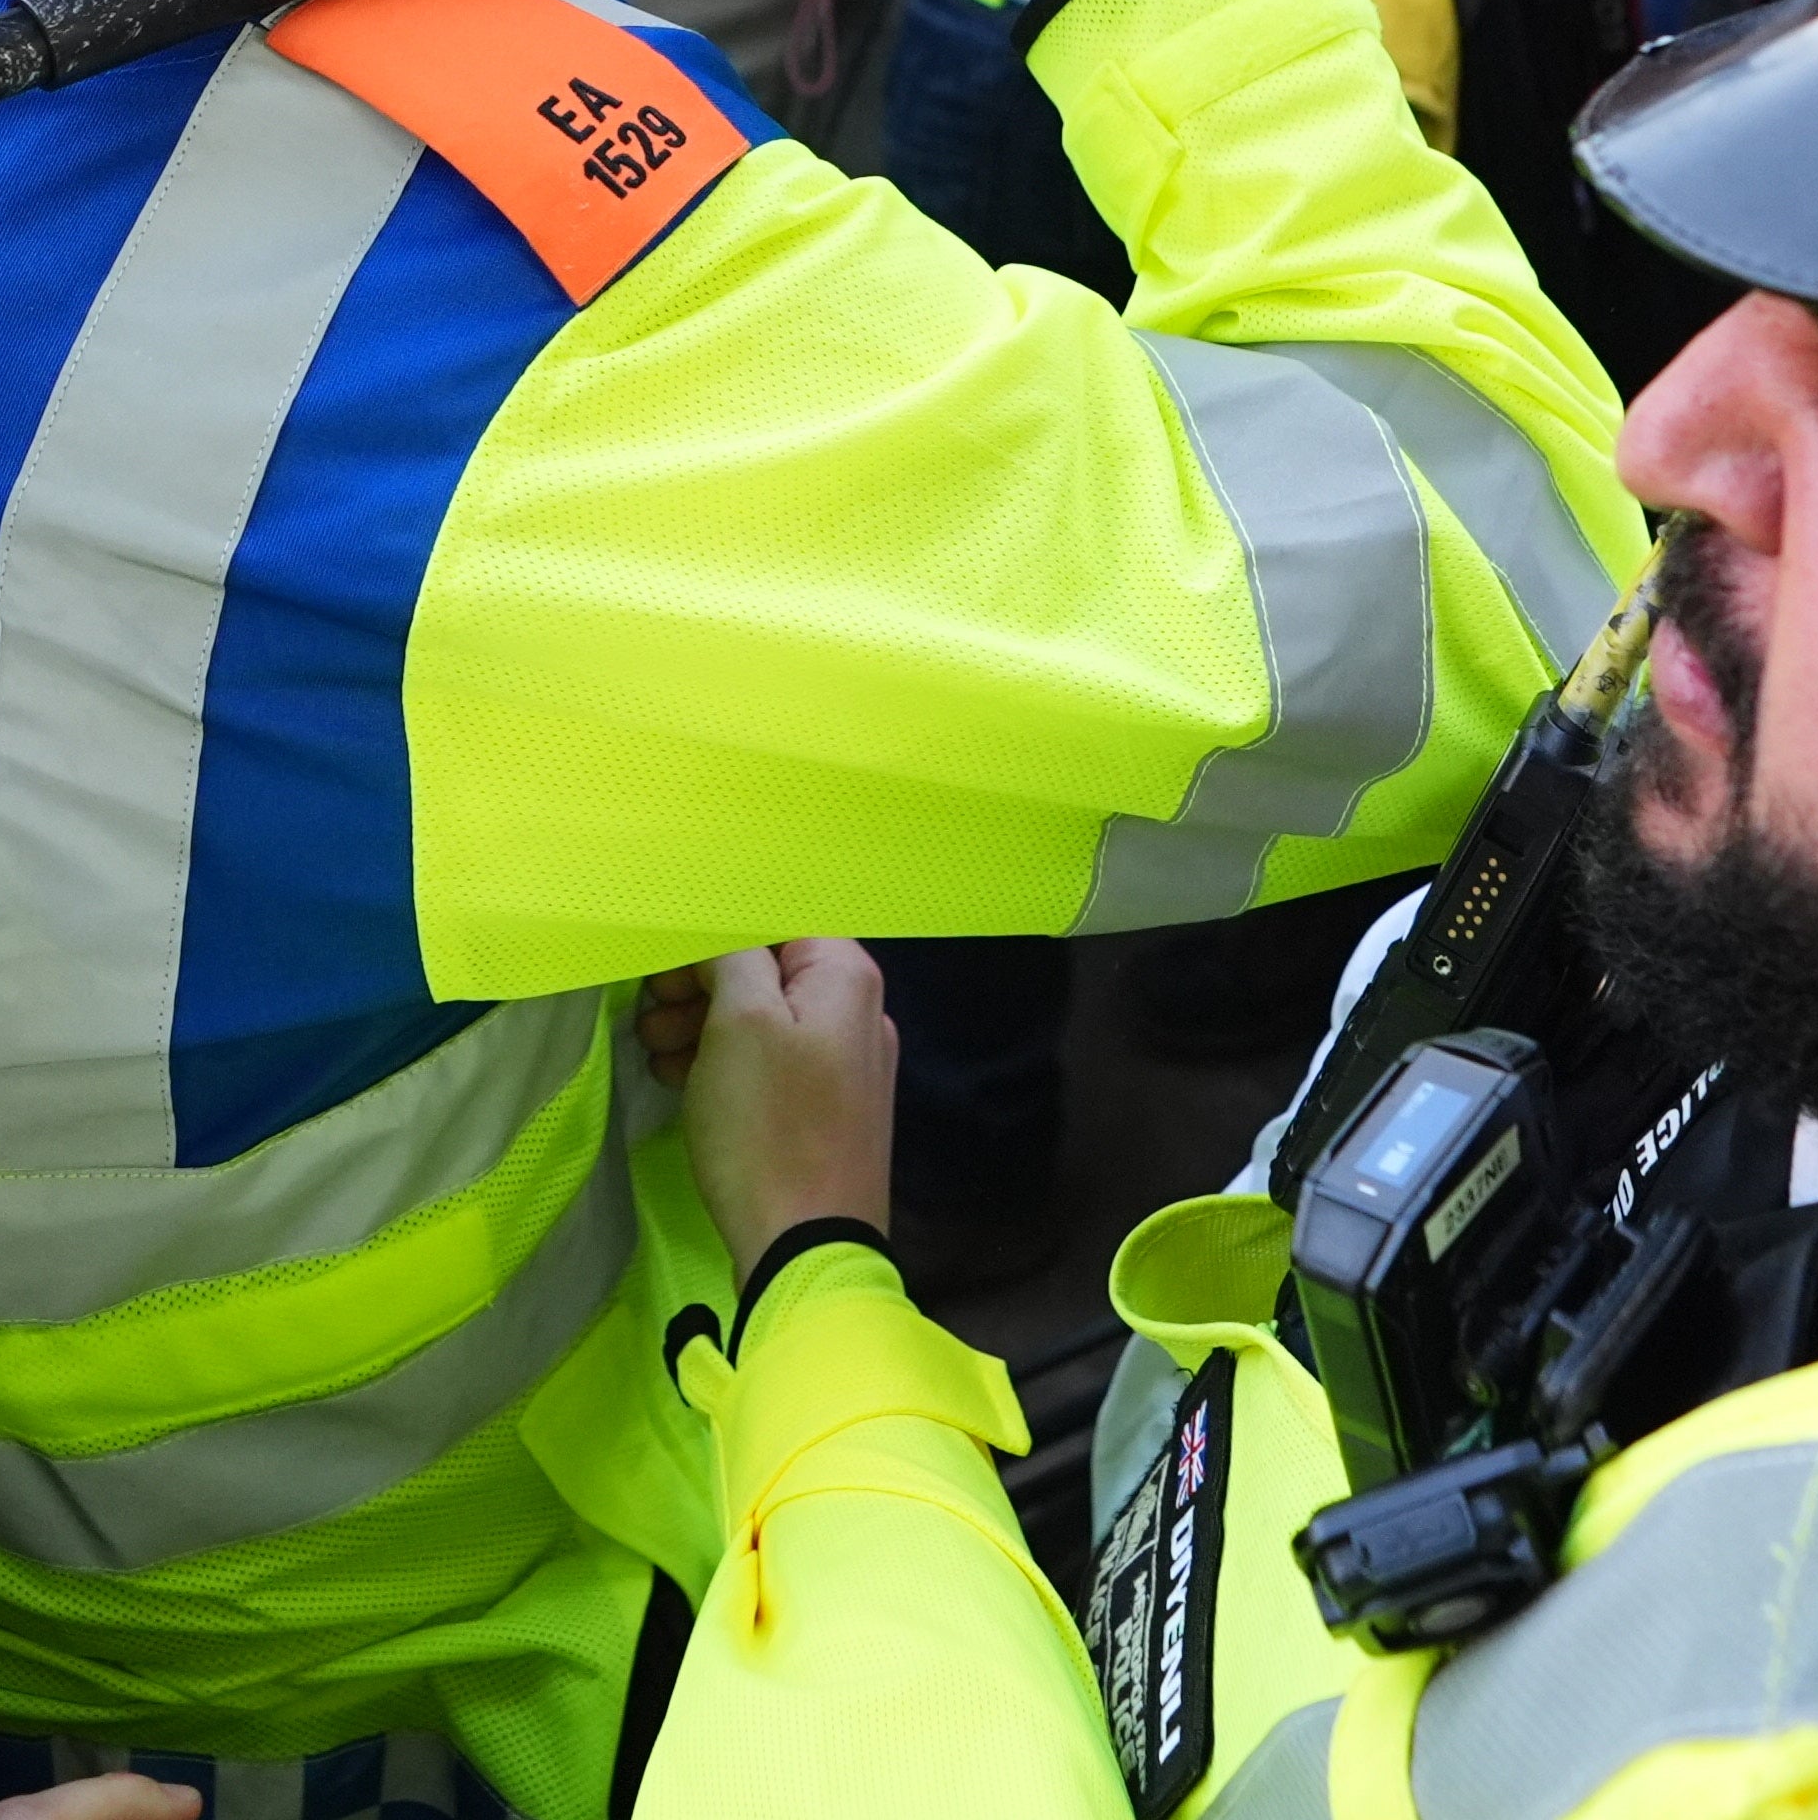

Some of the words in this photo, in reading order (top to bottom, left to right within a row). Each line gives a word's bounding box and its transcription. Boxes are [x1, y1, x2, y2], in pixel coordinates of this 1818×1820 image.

[537, 77, 623, 145] EA
[583, 105, 687, 200] 1529
[1112, 1616, 1137, 1780] POLICE
[1159, 1505, 1195, 1765] DIYENLI
